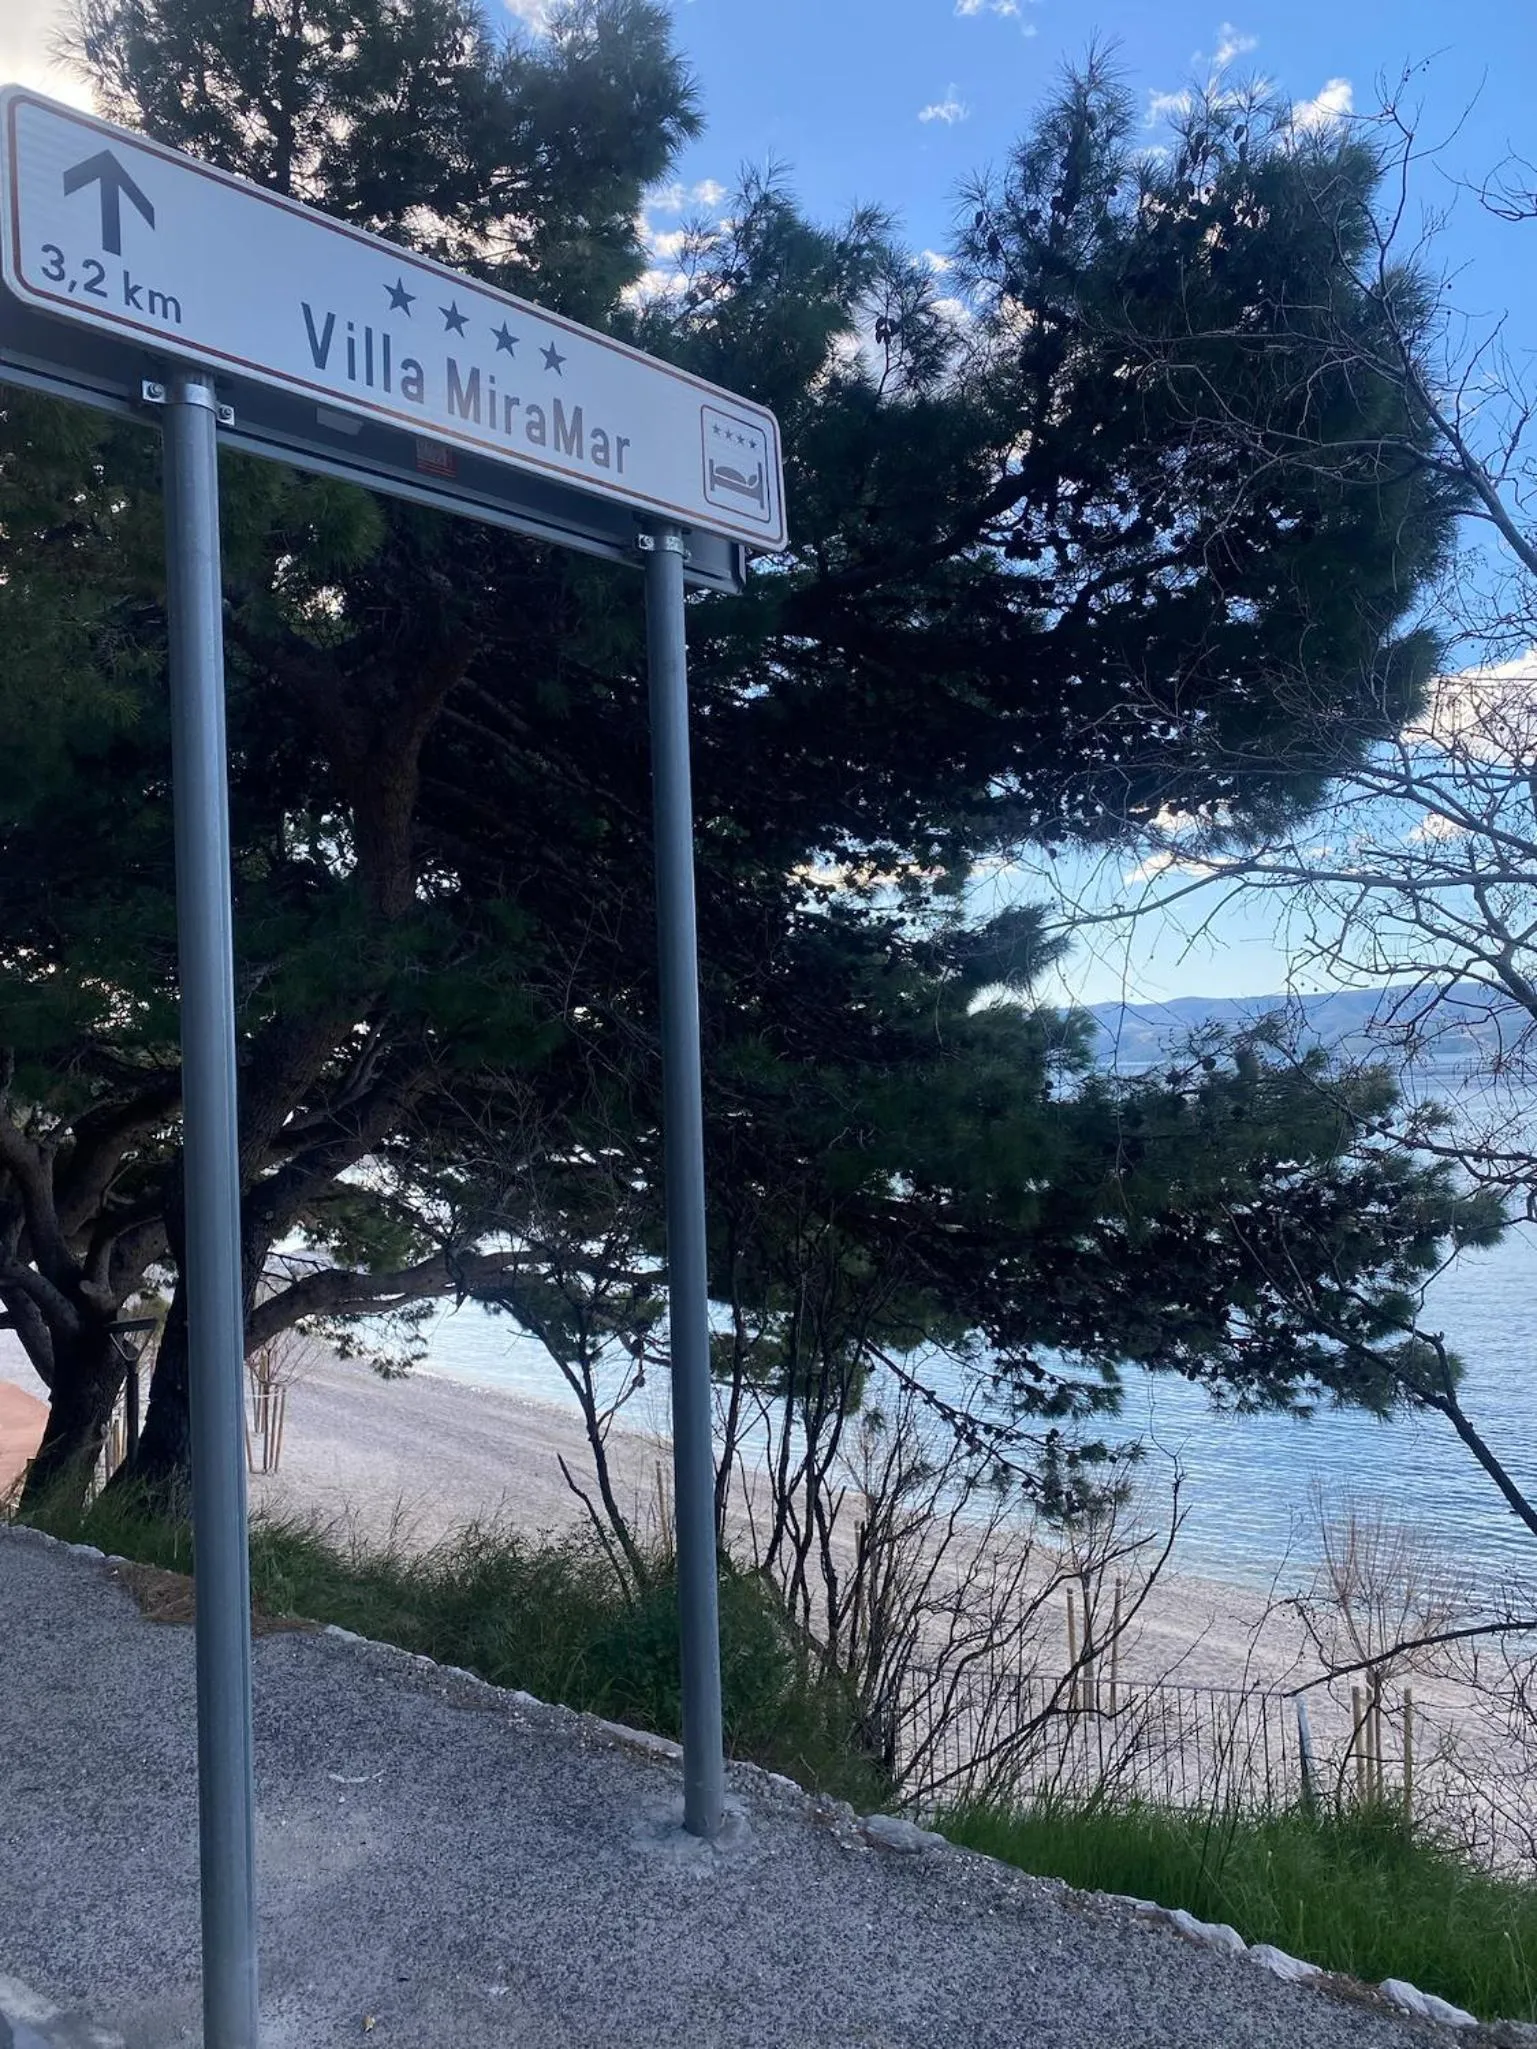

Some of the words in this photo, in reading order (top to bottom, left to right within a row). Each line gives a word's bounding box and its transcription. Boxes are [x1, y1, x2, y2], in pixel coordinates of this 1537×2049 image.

[41, 244, 108, 298] 3,2
[123, 270, 182, 323] km
[301, 301, 424, 404] Villa
[446, 356, 631, 474] MiraMar
